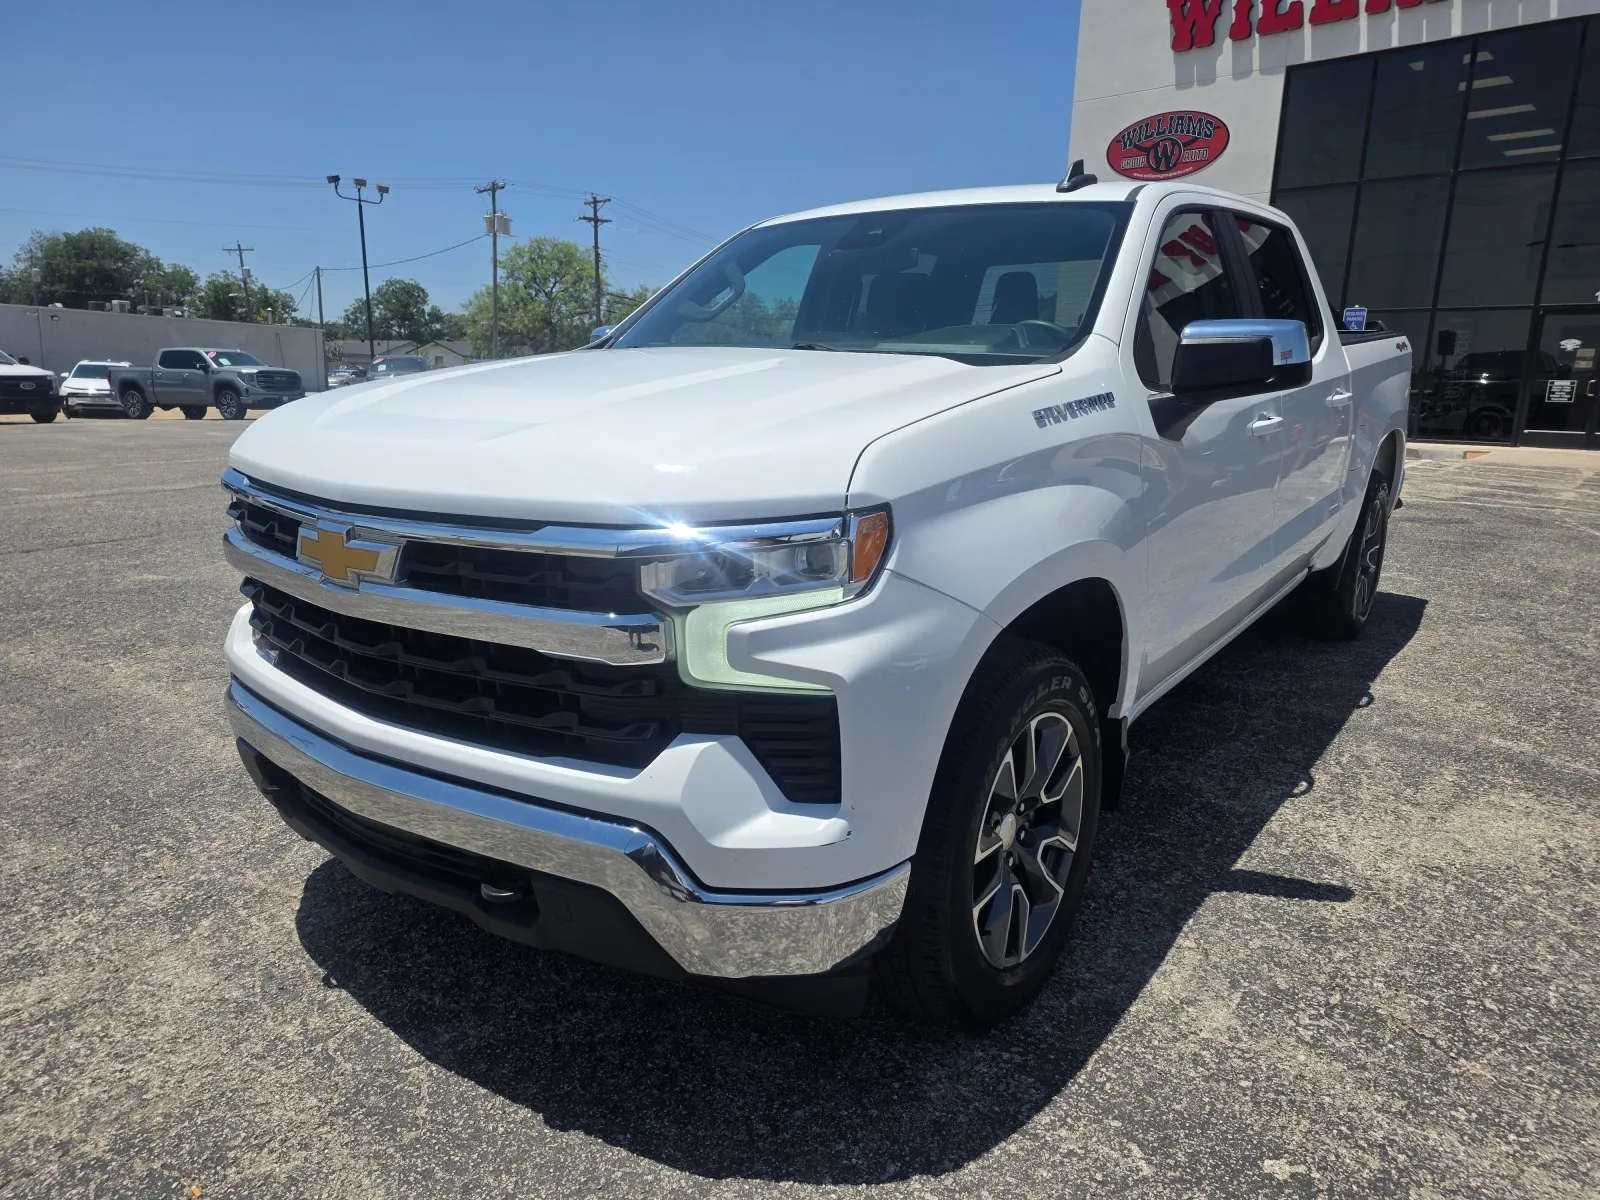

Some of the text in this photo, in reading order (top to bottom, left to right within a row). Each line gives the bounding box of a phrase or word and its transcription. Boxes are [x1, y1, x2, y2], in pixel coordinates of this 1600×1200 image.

[1121, 115, 1215, 151] WILLIAMS
[1121, 156, 1147, 169] GROUP
[1183, 148, 1209, 162] AUTO
[1031, 391, 1115, 423] SILVERADO
